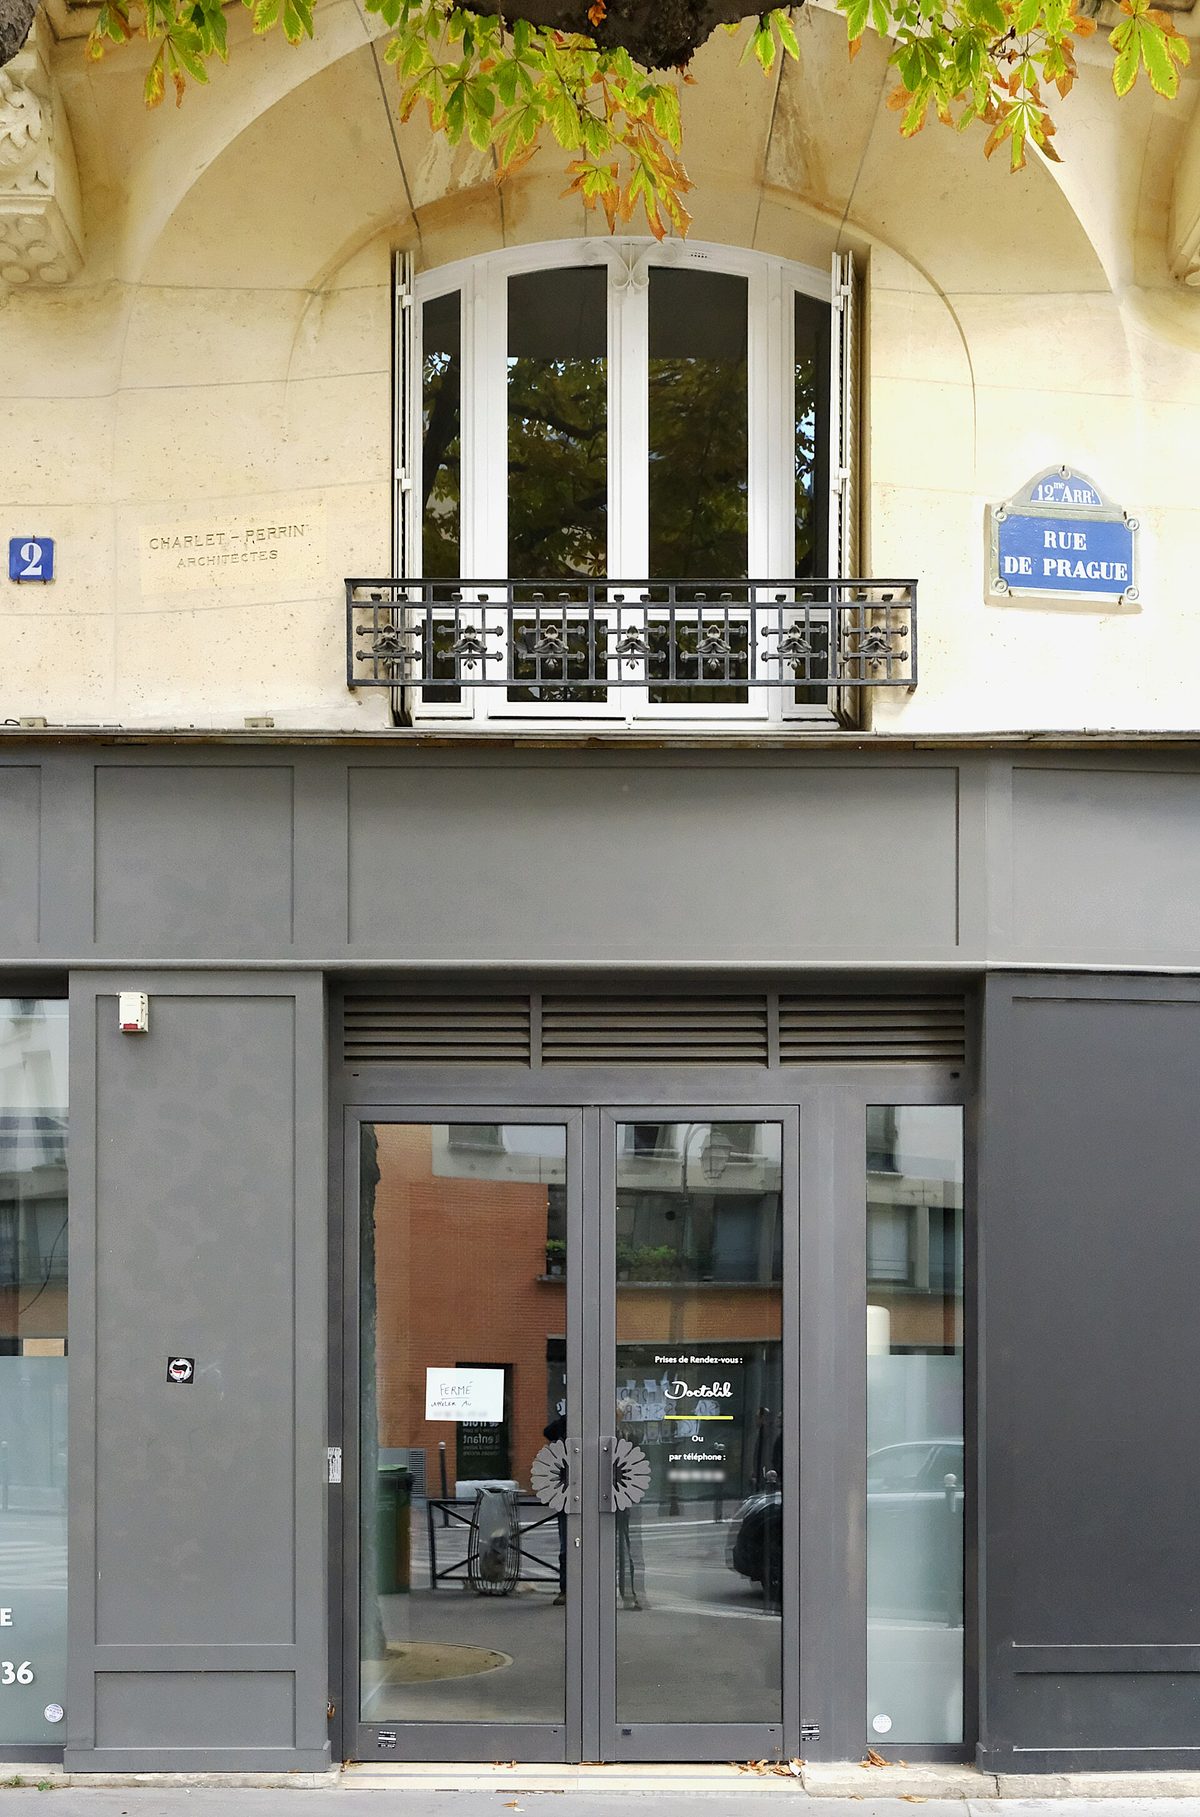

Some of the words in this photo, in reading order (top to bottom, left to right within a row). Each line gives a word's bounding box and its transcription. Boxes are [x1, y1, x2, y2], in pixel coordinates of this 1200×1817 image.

[149, 532, 225, 550] CHARLET
[246, 524, 305, 543] PERRIN
[1043, 530, 1087, 550] RUE
[20, 542, 42, 576] 2
[176, 550, 278, 568] ARCHITECTES
[1004, 556, 1032, 575] DE
[1043, 558, 1128, 581] PRAGUE
[654, 1355, 677, 1364] Prises
[678, 1355, 689, 1364] de
[690, 1355, 739, 1364] Rendez-vous
[440, 1381, 473, 1396] FERMÉ
[664, 1380, 734, 1400] Doctolib
[668, 1454, 682, 1462] par
[683, 1452, 722, 1463] téléphone
[1, 1661, 34, 1685] 36
